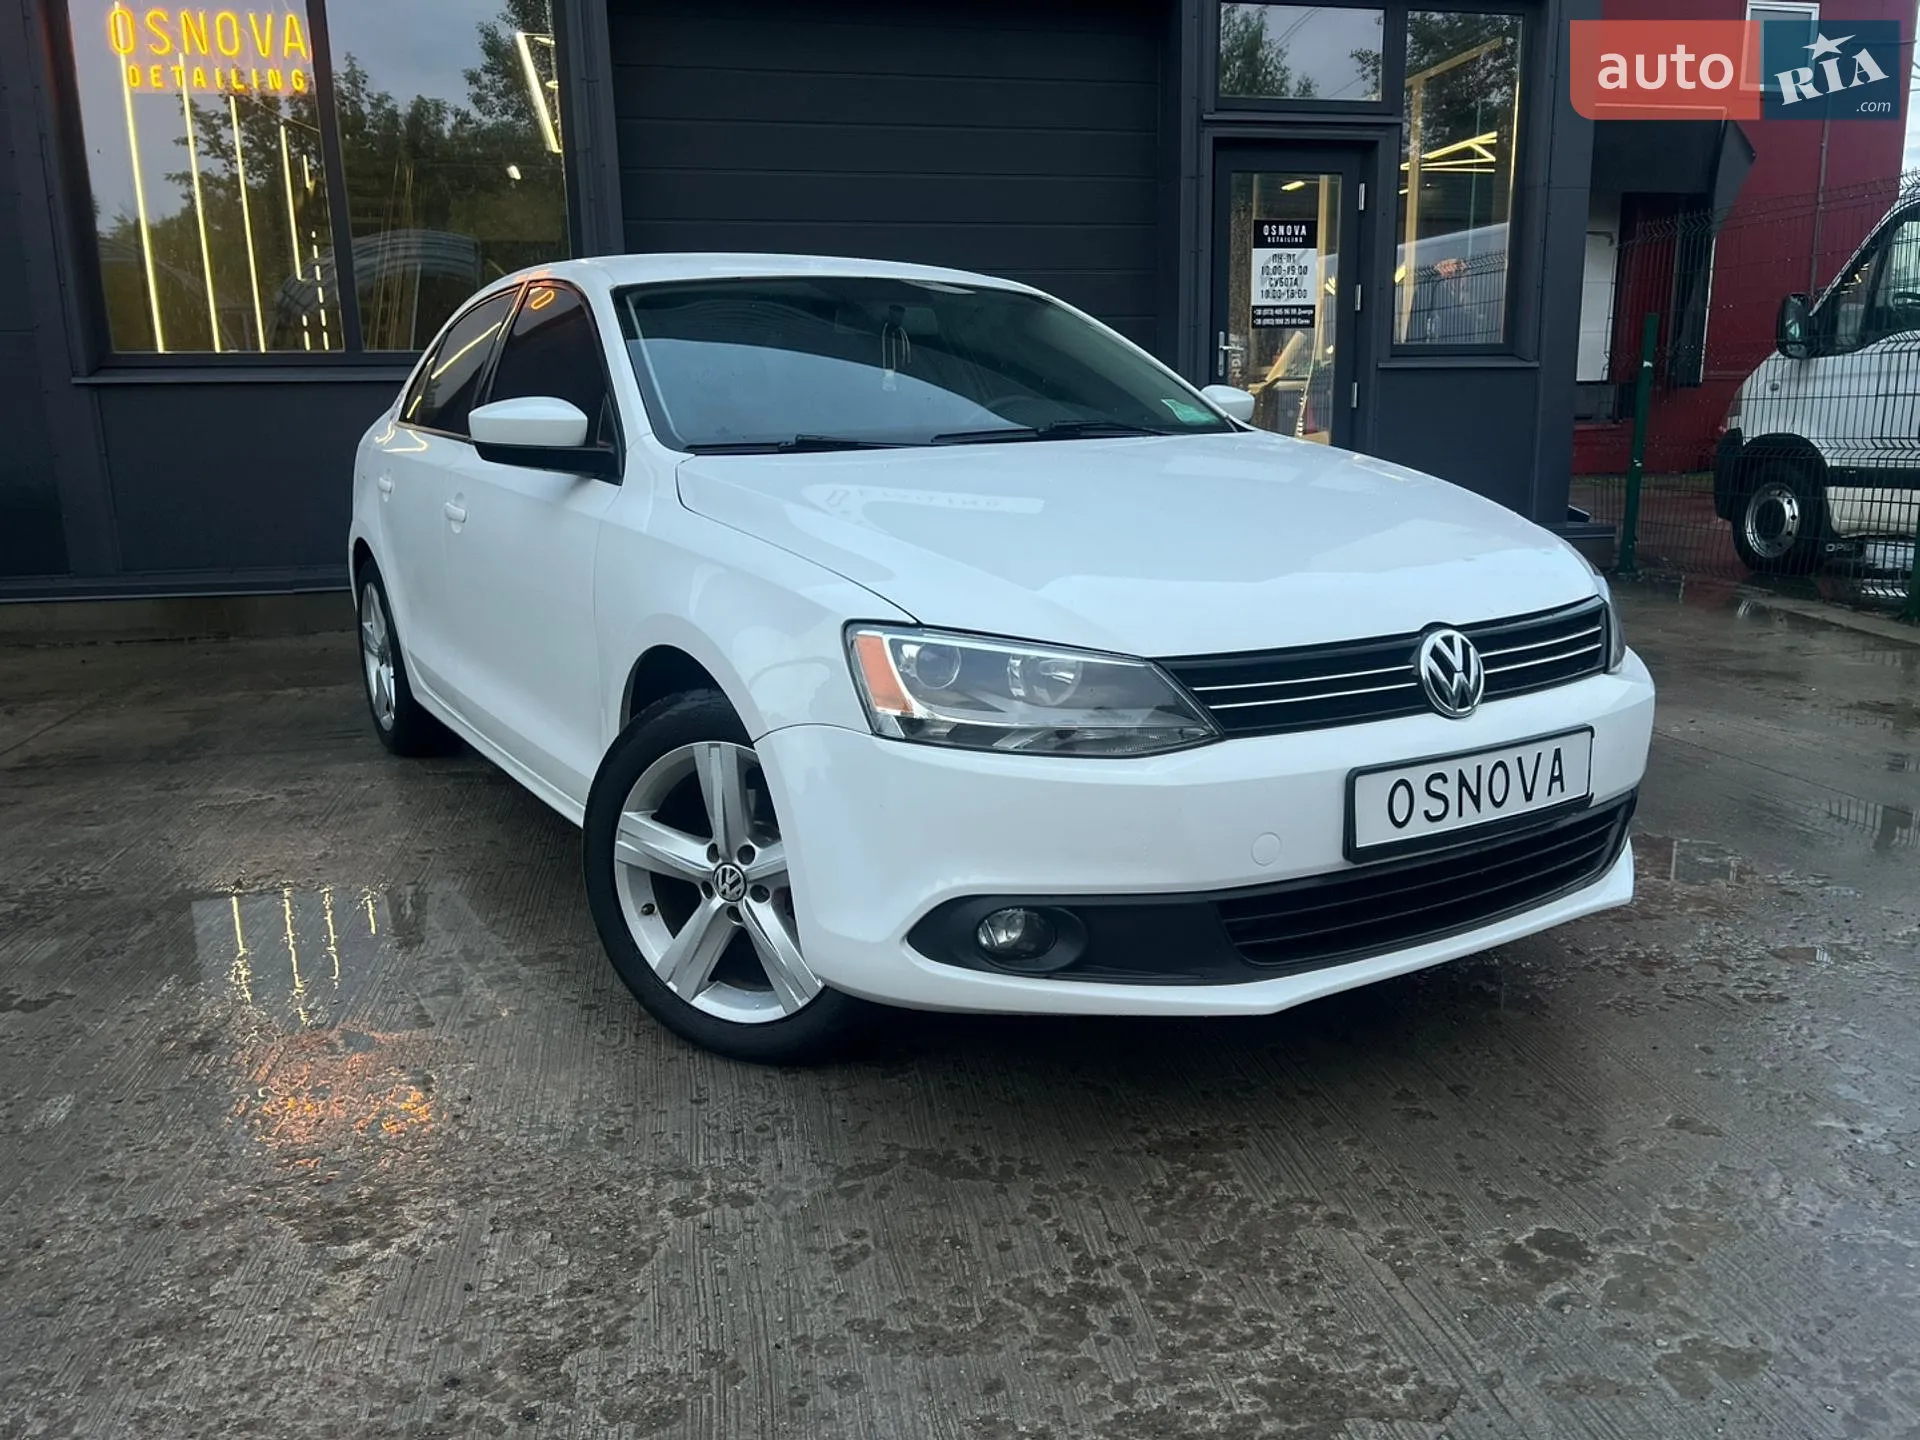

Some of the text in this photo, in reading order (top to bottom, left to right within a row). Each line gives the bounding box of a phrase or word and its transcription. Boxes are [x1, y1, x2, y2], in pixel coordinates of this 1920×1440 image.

[109, 8, 308, 60] OSNOVA
[127, 63, 308, 93] DETAILING
[1263, 225, 1307, 236] OSNOVA
[1388, 747, 1565, 829] OSNOVA
